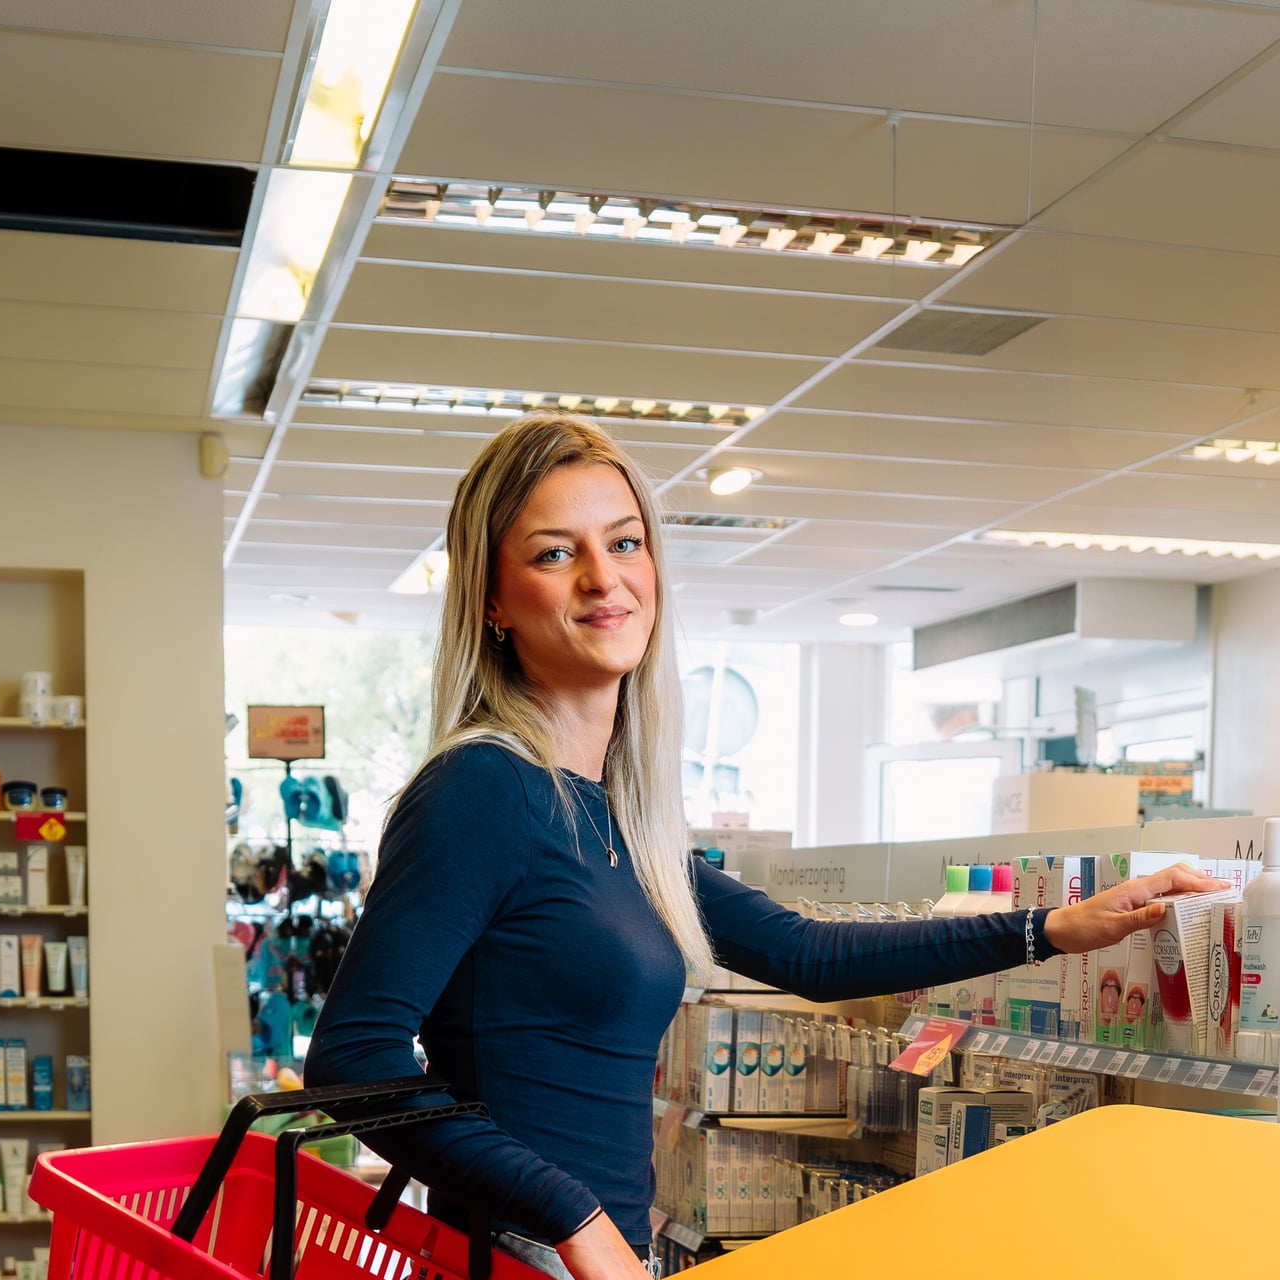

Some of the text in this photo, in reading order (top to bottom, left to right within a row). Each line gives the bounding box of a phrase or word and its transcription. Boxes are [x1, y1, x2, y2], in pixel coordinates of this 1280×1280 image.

[1246, 929, 1259, 940] TePe
[1153, 943, 1181, 956] CORSODYL
[1212, 942, 1223, 1022] CORSODYL
[1004, 1070, 1031, 1081] Interprox
[1055, 1074, 1091, 1085] Interprox
